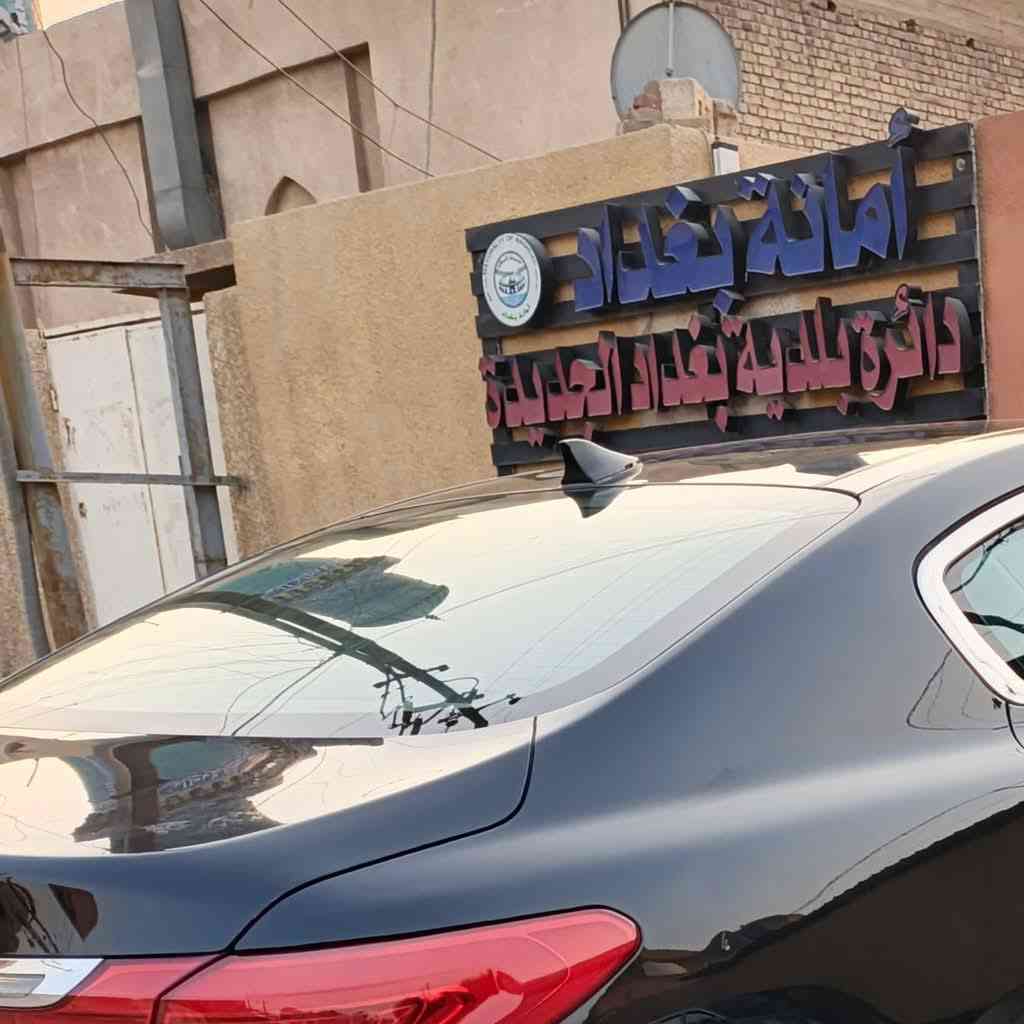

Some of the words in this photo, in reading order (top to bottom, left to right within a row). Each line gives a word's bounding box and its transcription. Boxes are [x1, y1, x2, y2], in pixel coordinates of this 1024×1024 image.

[574, 185, 738, 320] بغداد
[741, 108, 920, 276] أمانة
[480, 331, 622, 447] الجديدة
[629, 311, 730, 432] بغداد
[736, 297, 852, 420] بلدية
[852, 284, 962, 412] دائرة
